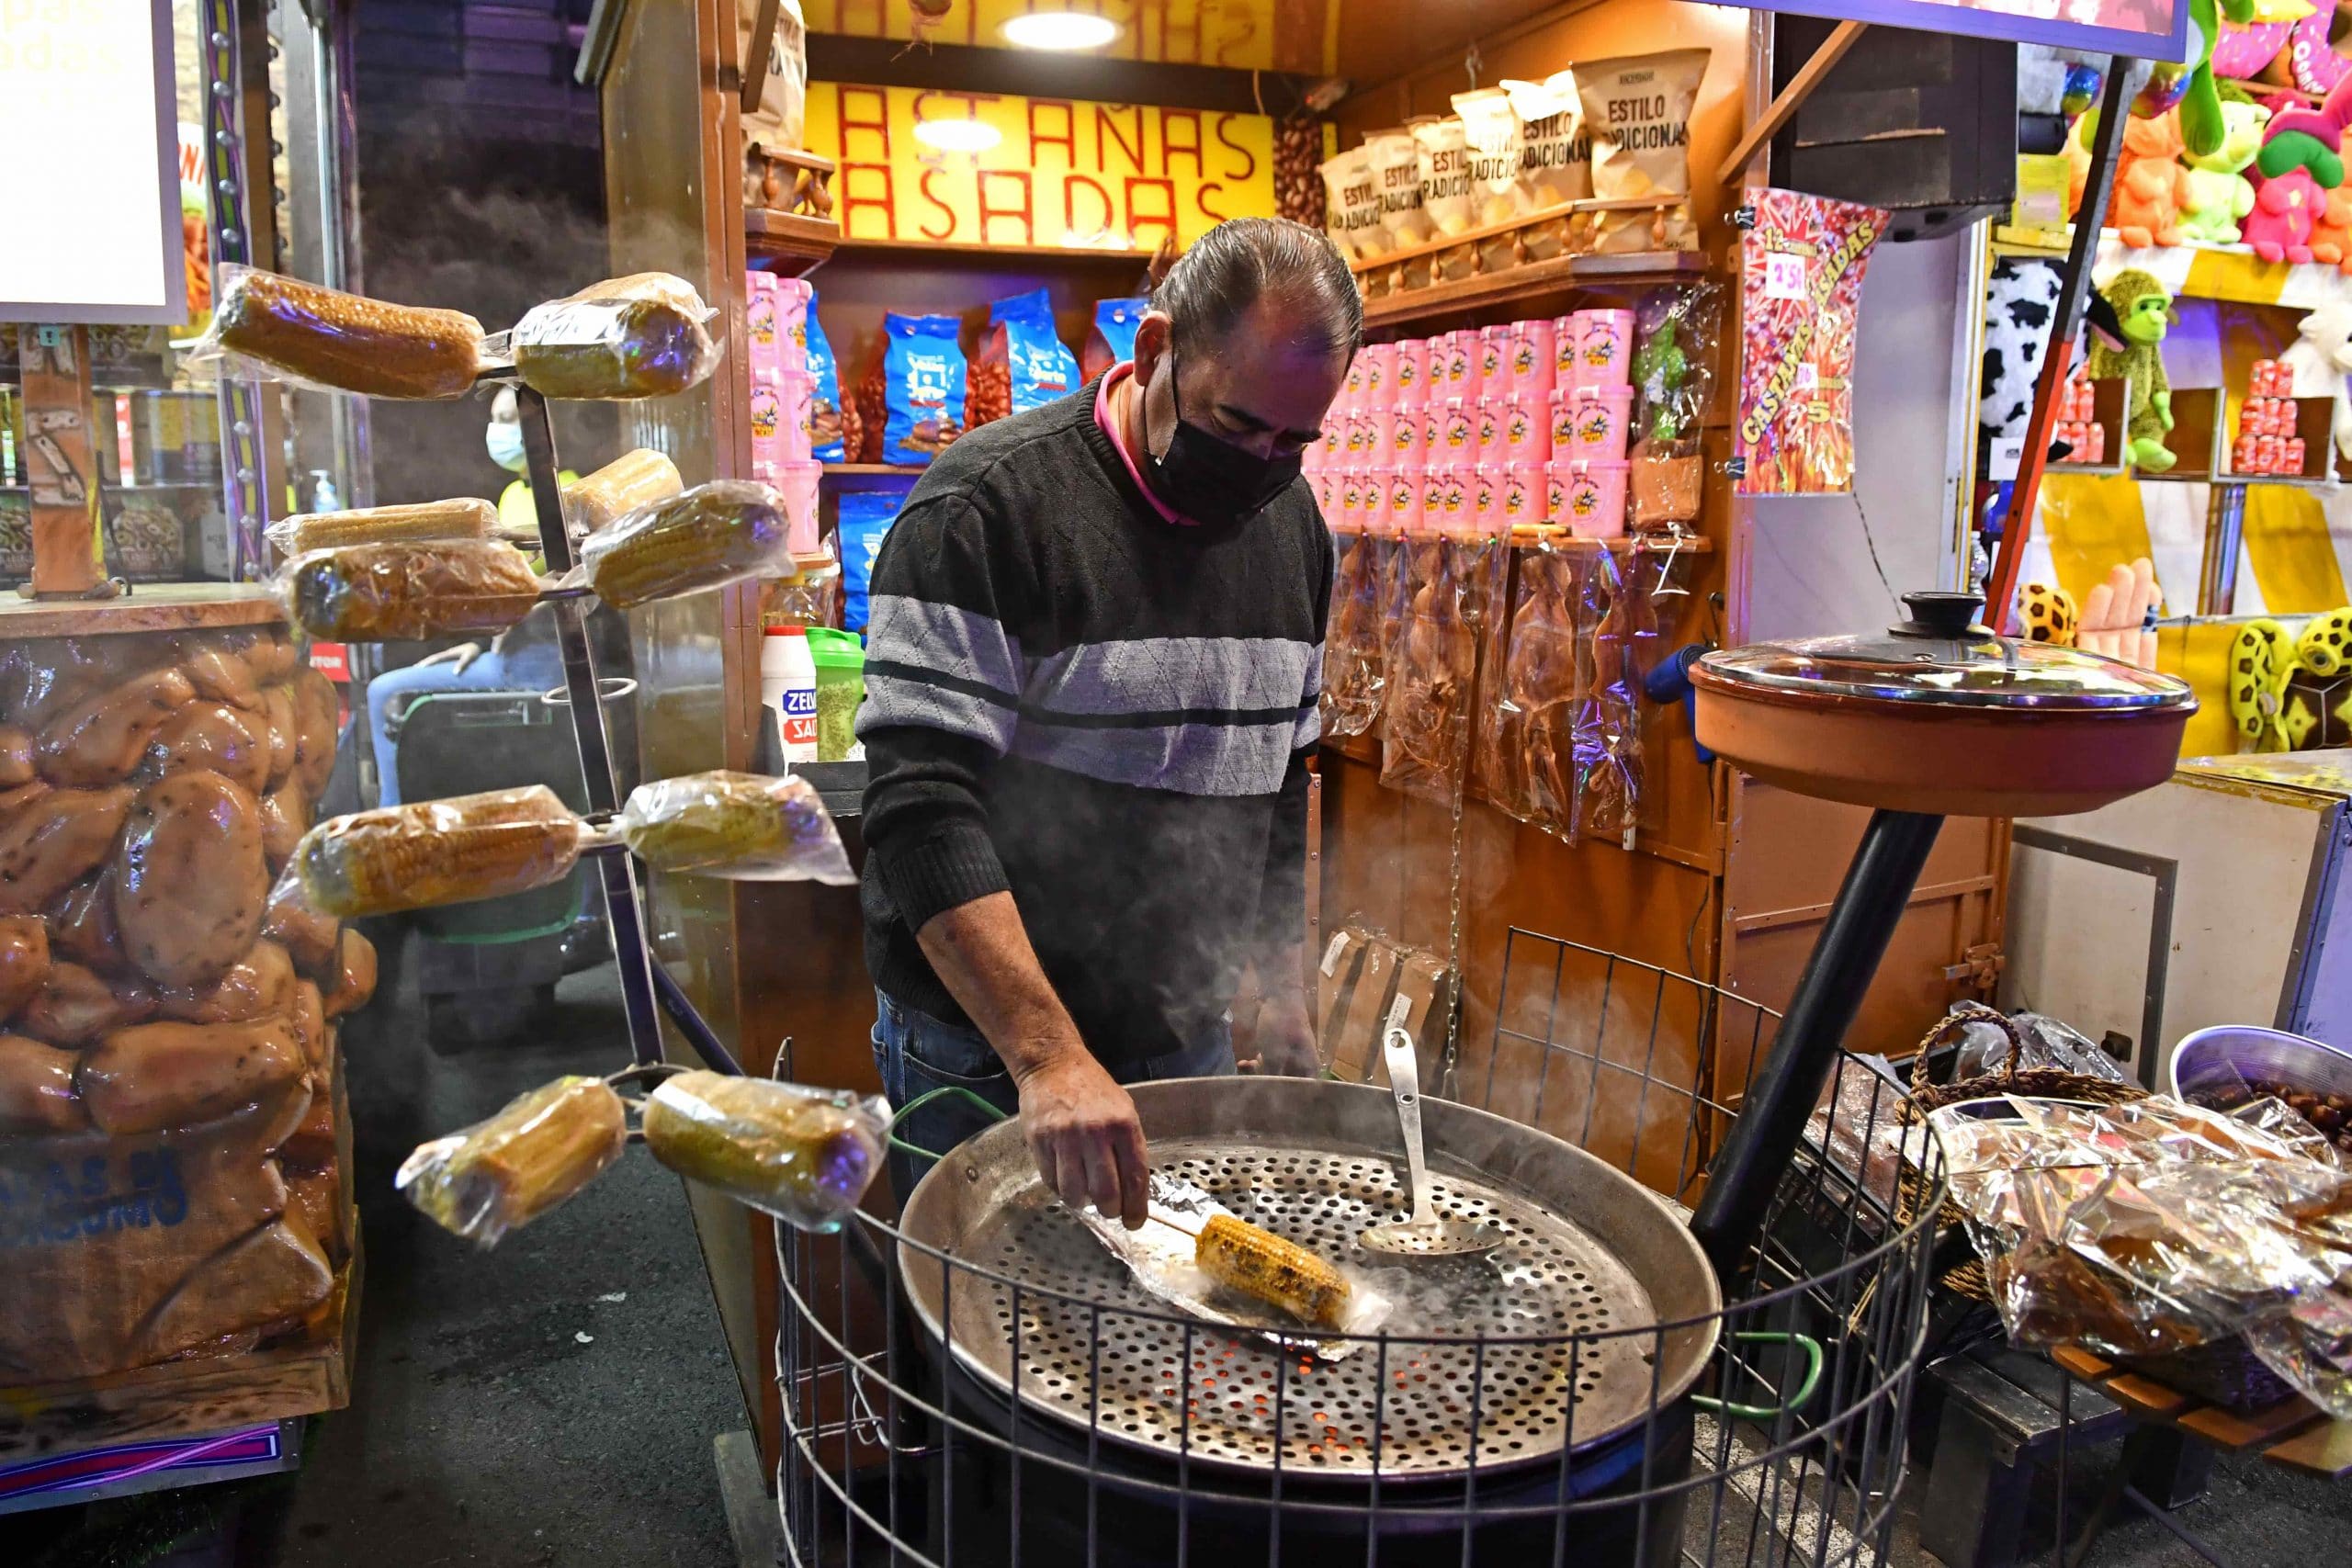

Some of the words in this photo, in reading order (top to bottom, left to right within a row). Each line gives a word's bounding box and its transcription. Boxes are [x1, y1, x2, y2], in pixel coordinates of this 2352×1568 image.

[1608, 95, 1665, 123] ESTILO
[805, 83, 1255, 181] ASTAÑAS
[1764, 227, 1784, 251] 12
[1807, 400, 1831, 423] 5
